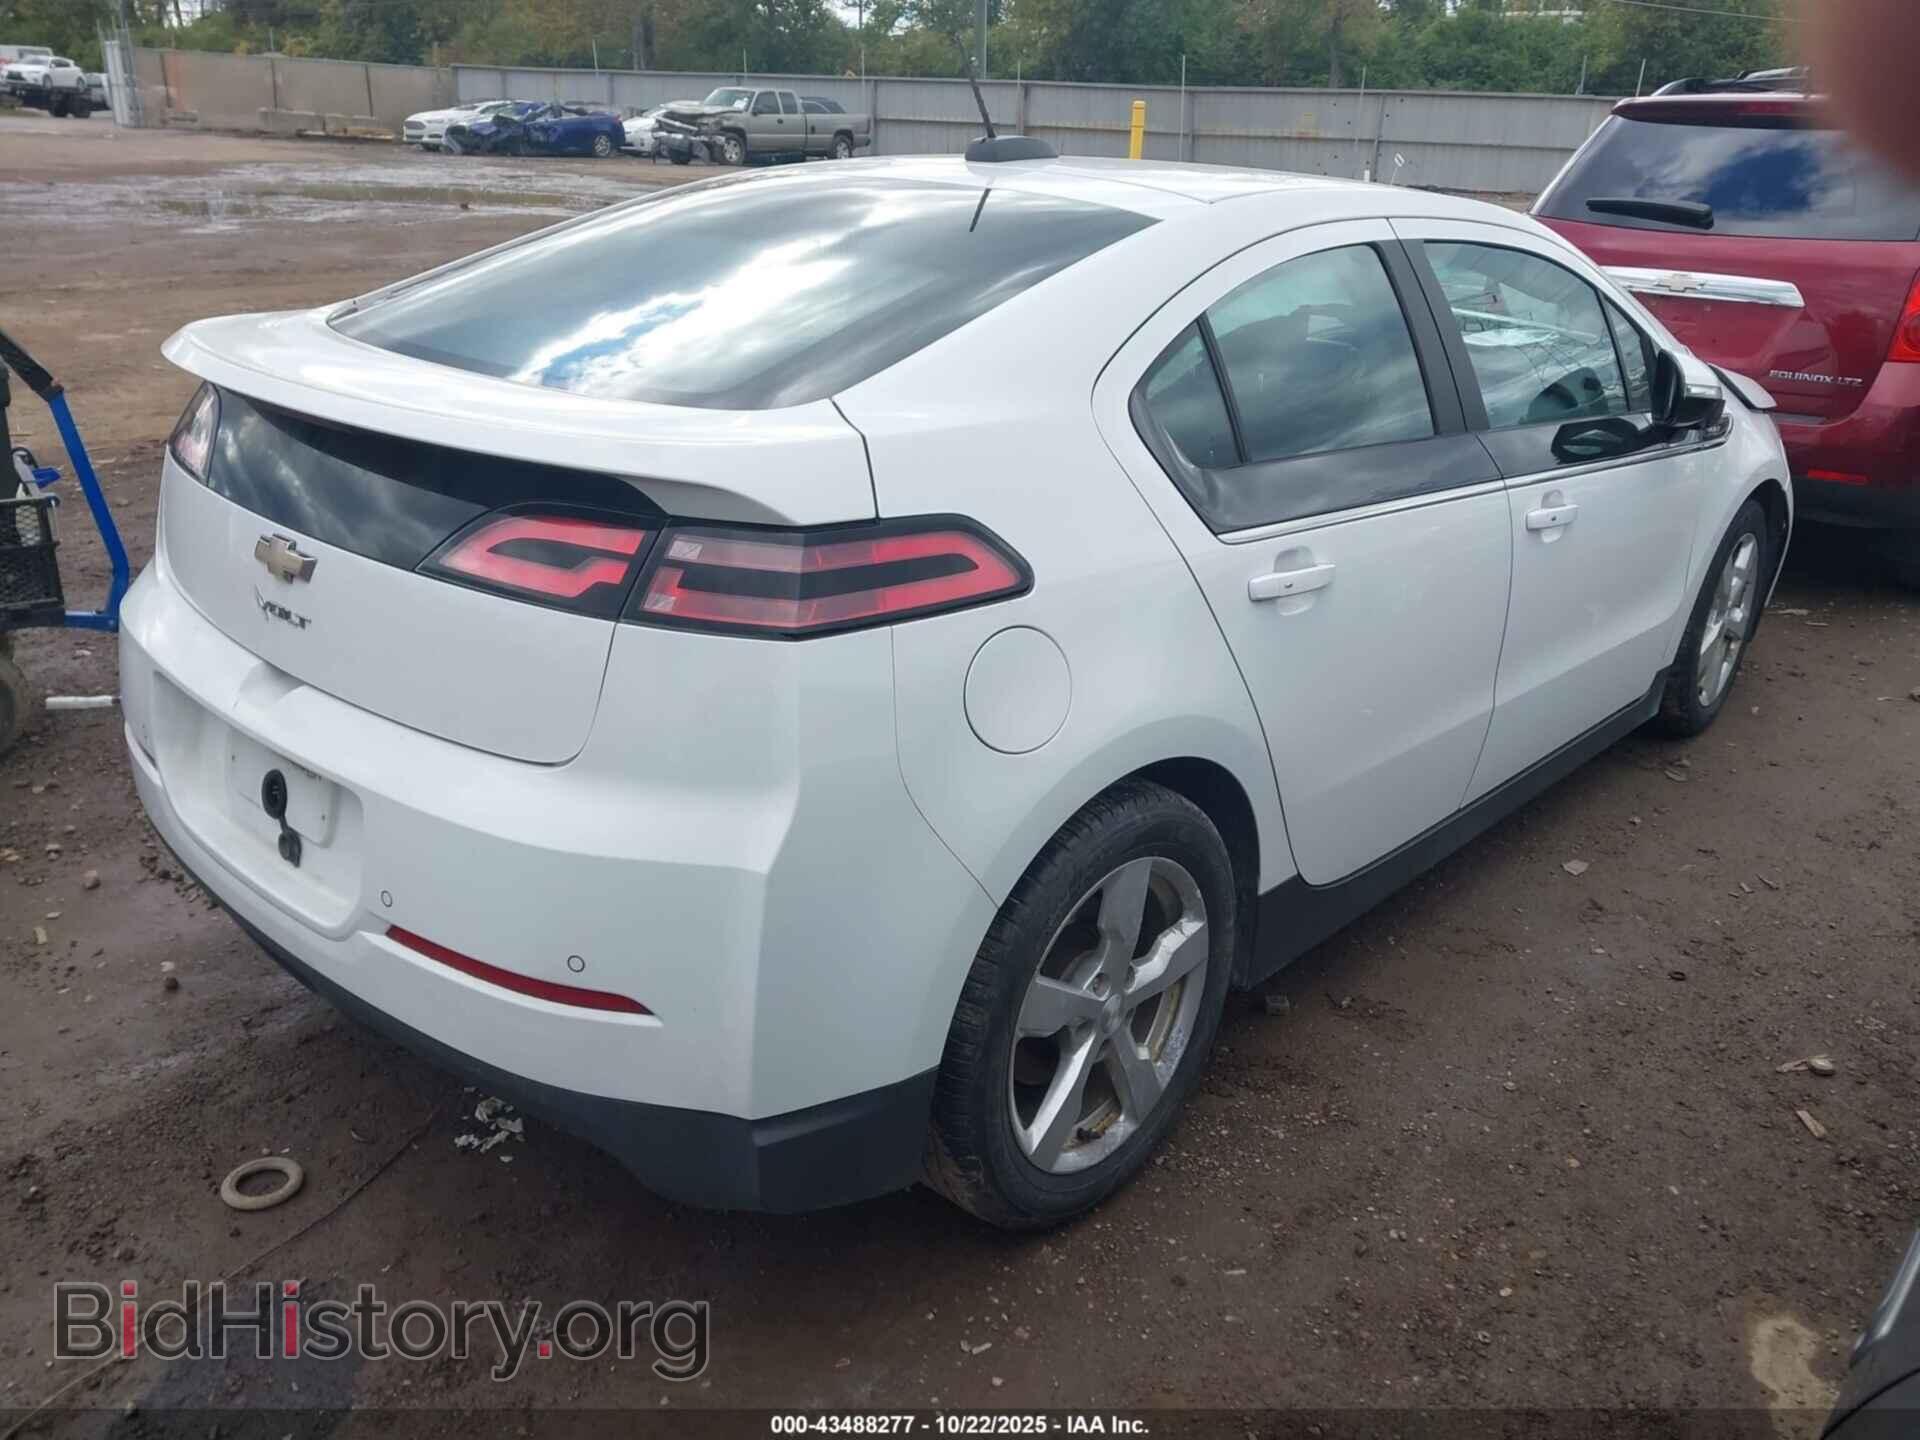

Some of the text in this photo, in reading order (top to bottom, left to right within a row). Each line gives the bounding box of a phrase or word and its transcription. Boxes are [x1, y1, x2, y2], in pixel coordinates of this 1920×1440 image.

[1768, 369, 1863, 386] EQUINOX LTZ
[254, 584, 312, 630] VOLT
